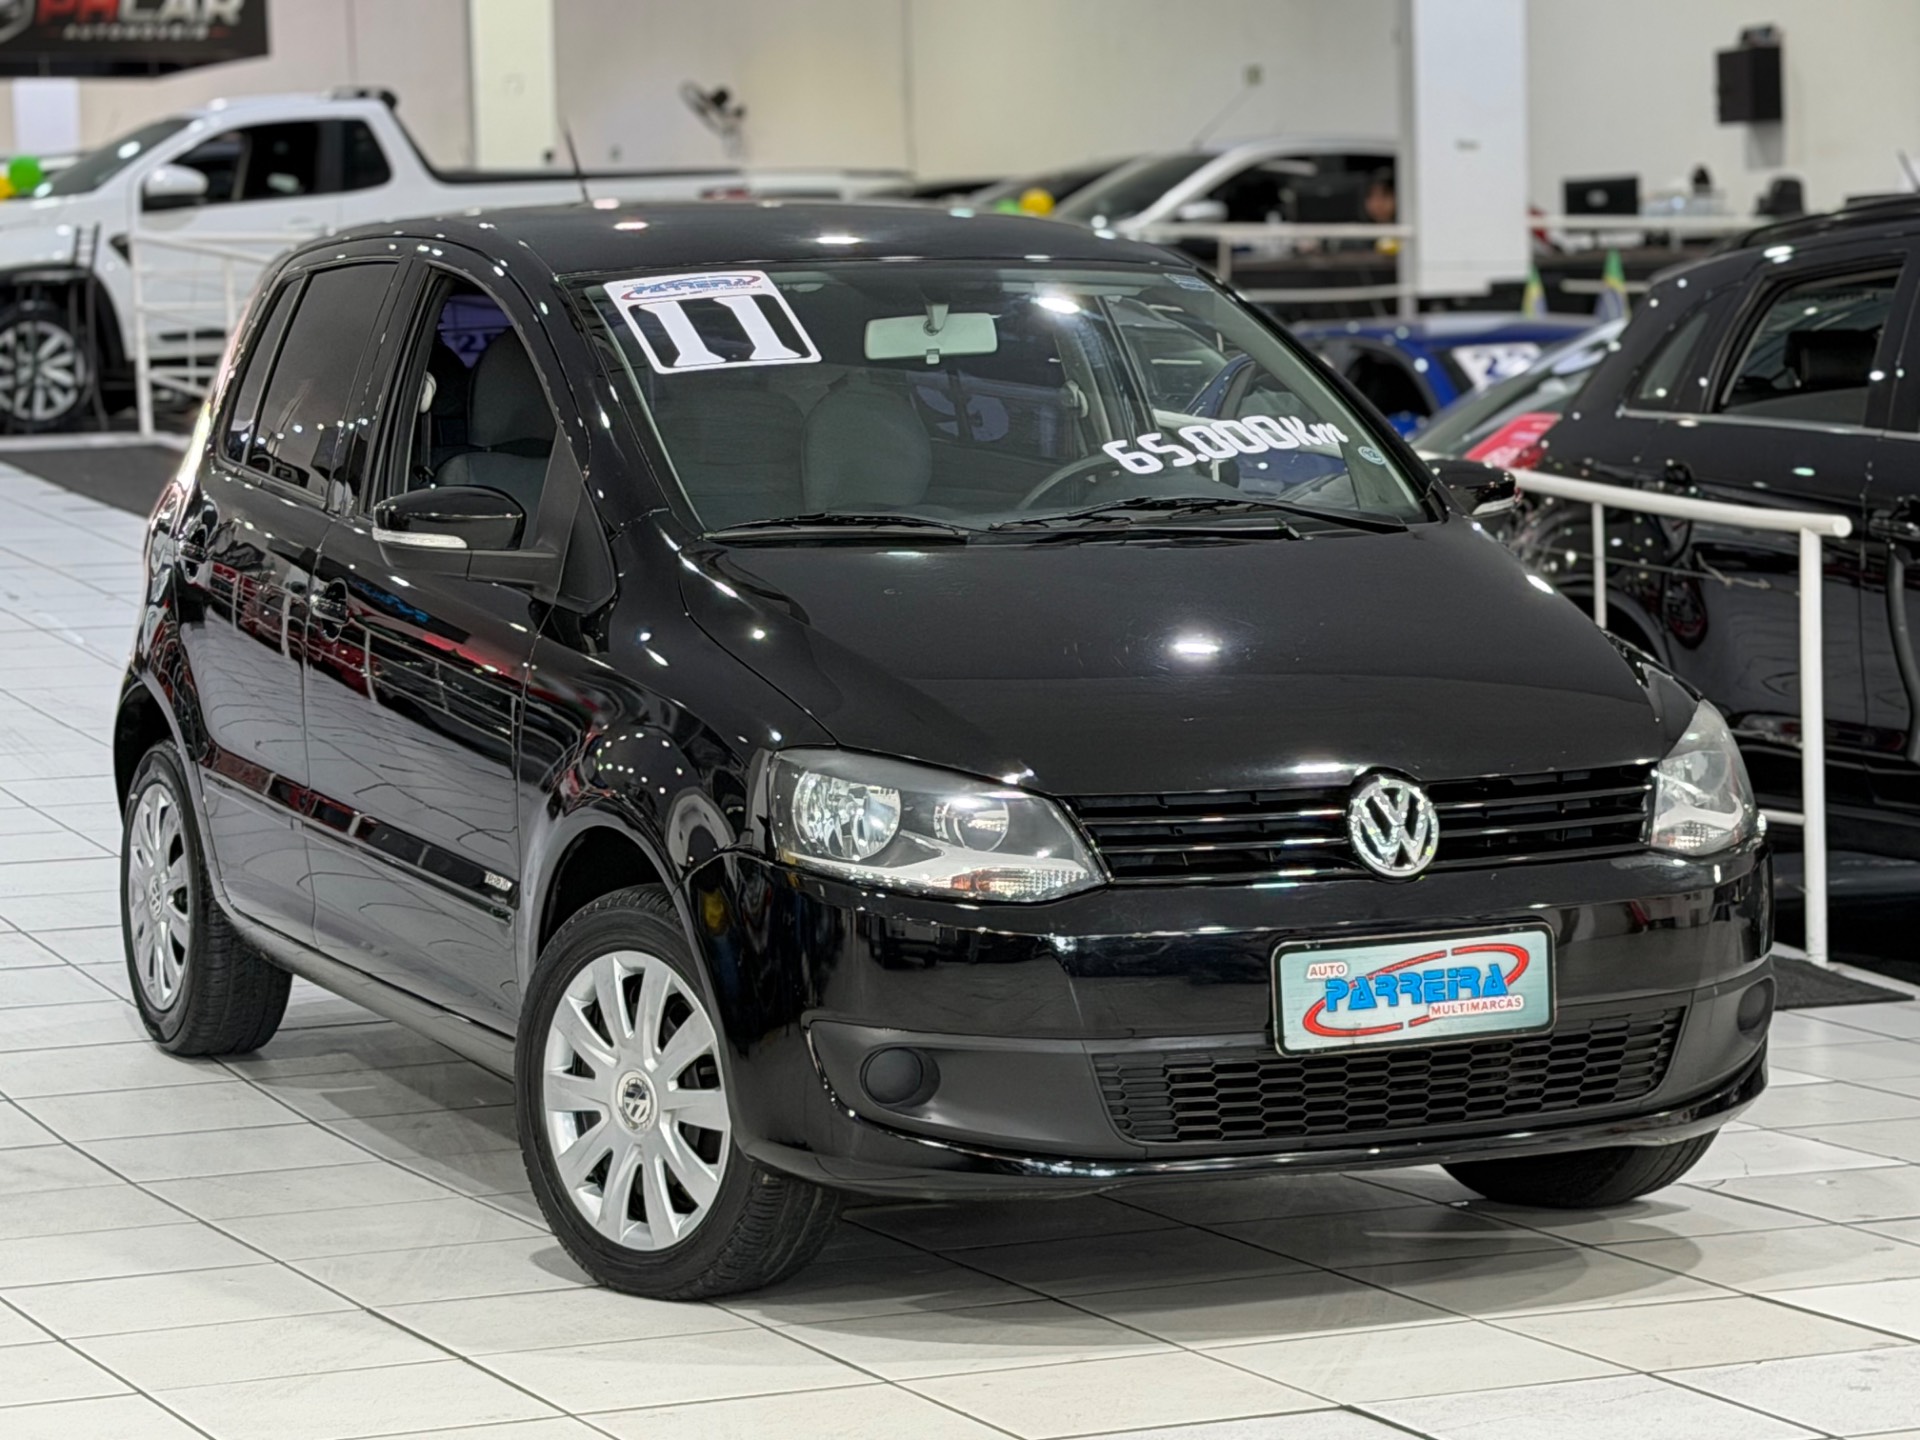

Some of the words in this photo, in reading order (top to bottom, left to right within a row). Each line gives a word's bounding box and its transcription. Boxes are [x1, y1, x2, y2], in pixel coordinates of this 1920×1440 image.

[1309, 963, 1346, 978] AUTO
[1325, 963, 1509, 1012] PARREIRA
[1430, 997, 1522, 1017] MULTIMARCAS
